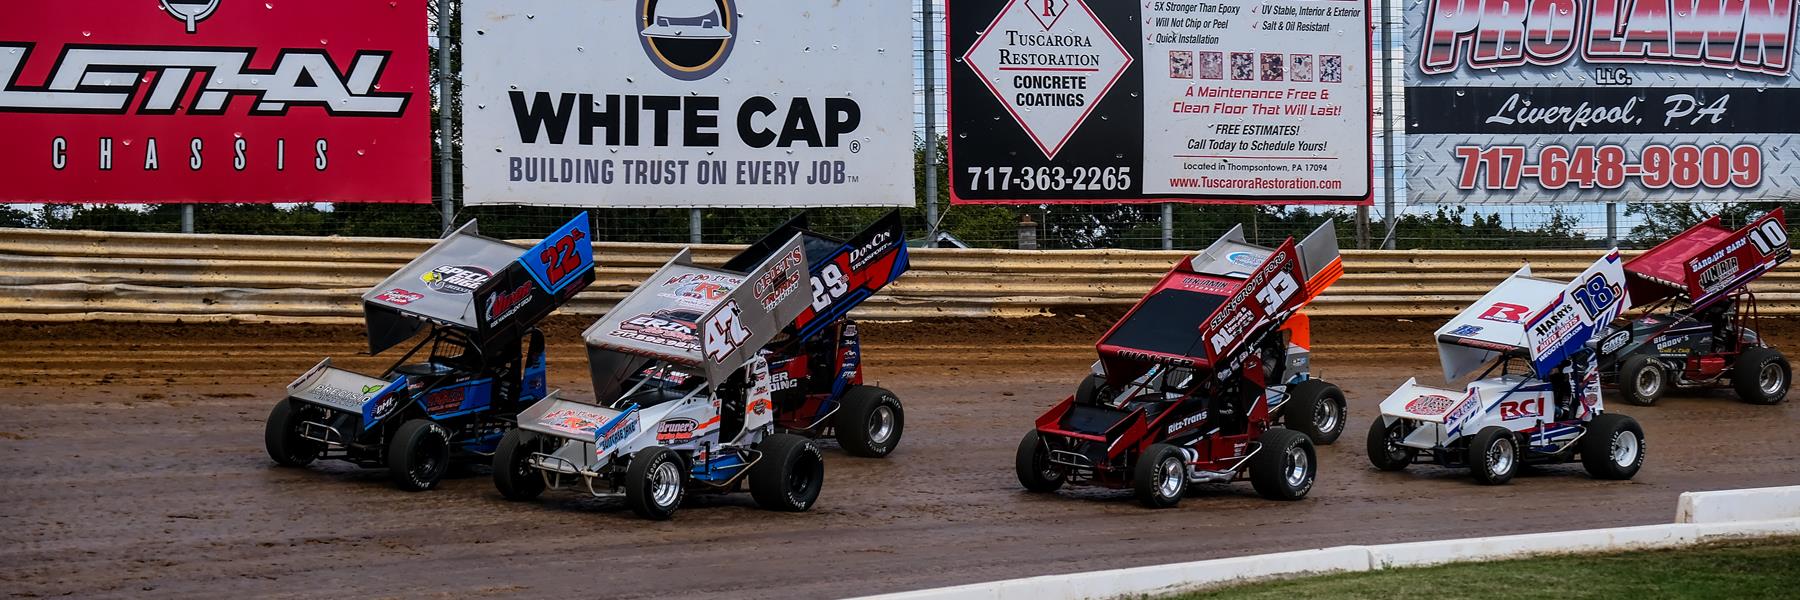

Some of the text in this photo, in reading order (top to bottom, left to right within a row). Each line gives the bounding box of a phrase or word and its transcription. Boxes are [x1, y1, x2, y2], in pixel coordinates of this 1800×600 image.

[1154, 2, 1240, 16] 5X Stronger Than Epoxy
[1262, 5, 1361, 18] UV Stable, Interior & Exterior
[1155, 17, 1228, 31] Will Not Chip or Peel
[1262, 21, 1330, 32] Salt & Oil Resistant
[1156, 33, 1219, 45] Quick Installation
[1420, 0, 1798, 76] PRO LAWN
[0, 41, 412, 117] LETHAL
[1013, 75, 1087, 89] CONCRETE
[1595, 67, 1632, 86] LLC.
[1016, 92, 1085, 107] COATINGS
[1185, 87, 1329, 100] A Maintenance Free &
[1173, 102, 1342, 116] Clean Floor That Will Last!
[1485, 93, 1731, 136] Liverpool, PA
[508, 90, 862, 149] WHITE CAP
[1215, 124, 1300, 136] FREE ESTIMATES!
[1188, 138, 1327, 152] Call Today to Schedule Yours!
[52, 136, 328, 171] CHASSIS
[509, 157, 614, 185] BUILDING
[623, 159, 689, 185] TRUST
[698, 160, 727, 185] ON
[736, 160, 799, 185] EVERY
[807, 161, 846, 185] JOB
[1184, 162, 1327, 173] Located in Thompsontown, PA 17094
[1455, 144, 1762, 190] 717-648-9809
[967, 166, 1131, 191] 717-363-2265
[1170, 176, 1342, 190] www.TuscaroraRestoration.com
[1748, 217, 1789, 257] 10
[1692, 237, 1747, 272] BARGAIN BARN
[1263, 251, 1287, 278] FORD
[1183, 277, 1228, 288] BENJAMIN
[1535, 304, 1573, 337] HARRY'S
[1654, 334, 1667, 344] BIG
[1657, 335, 1689, 350] DADDY'S
[315, 384, 371, 403] PRECISIO
[1500, 397, 1545, 421] RCI
[657, 421, 695, 433] Bruner's
